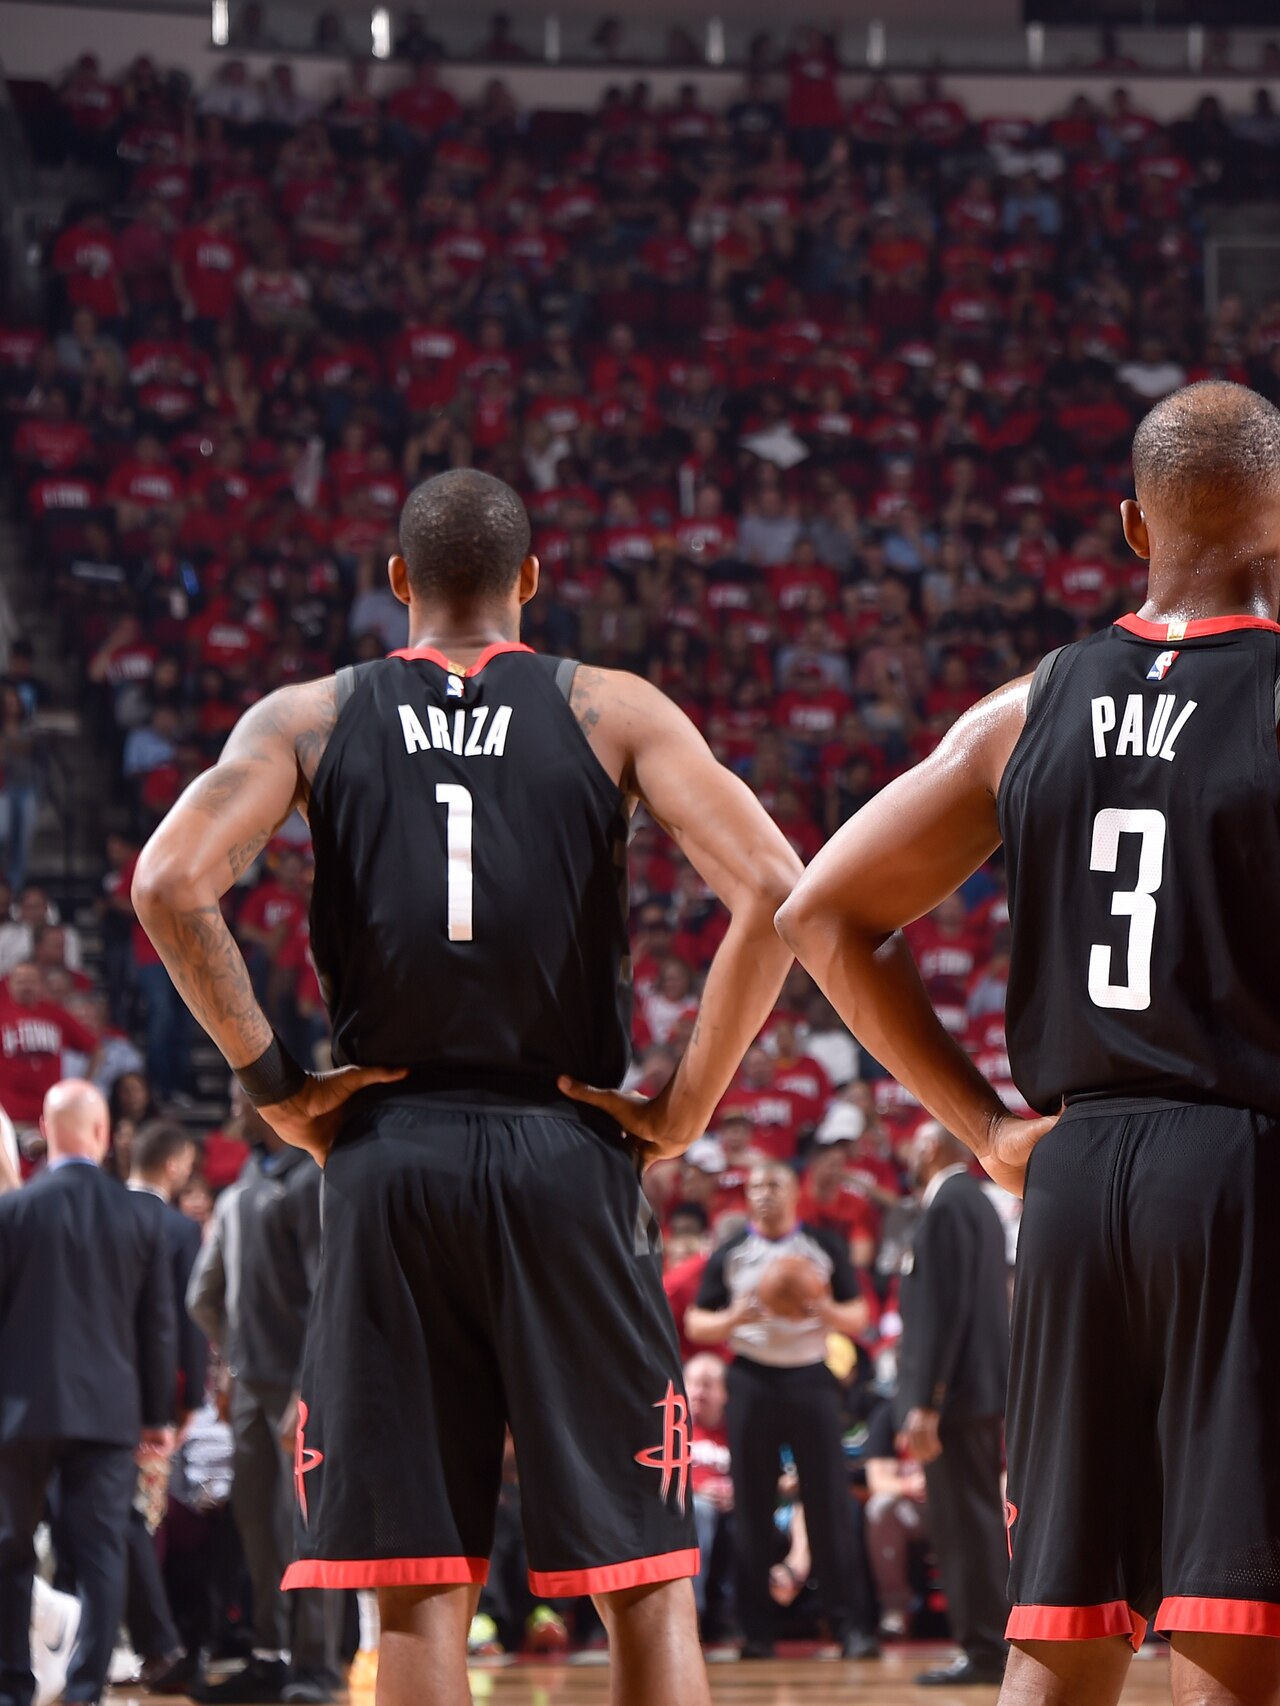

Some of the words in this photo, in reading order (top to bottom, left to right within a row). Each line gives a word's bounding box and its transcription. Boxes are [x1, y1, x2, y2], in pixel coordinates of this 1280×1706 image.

[398, 703, 513, 757] ARIZA
[1090, 693, 1198, 763] PAUL
[435, 783, 473, 941] 1
[1087, 807, 1167, 1011] 3
